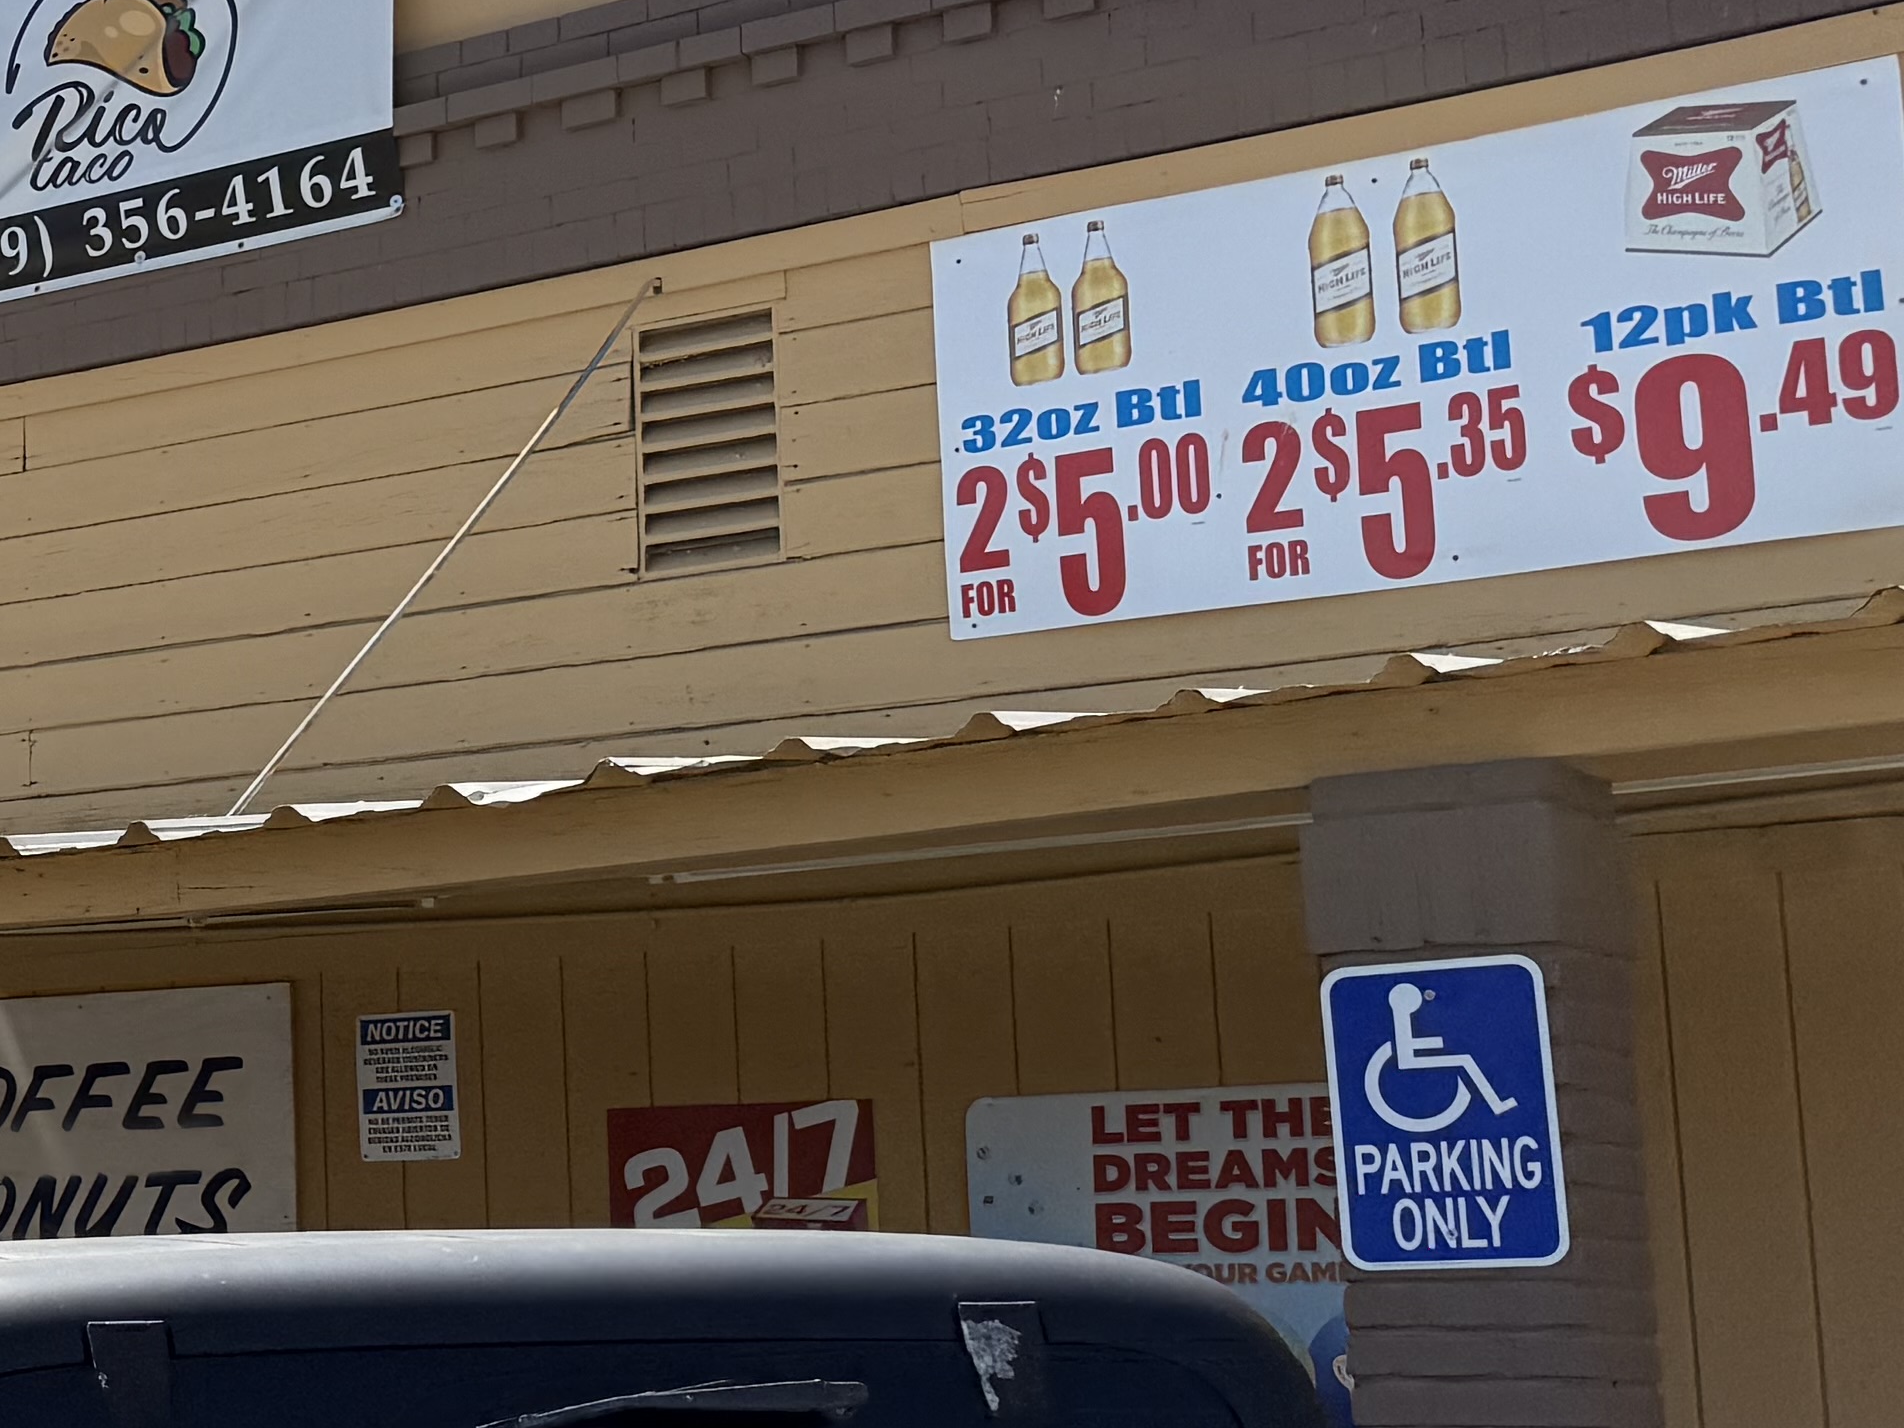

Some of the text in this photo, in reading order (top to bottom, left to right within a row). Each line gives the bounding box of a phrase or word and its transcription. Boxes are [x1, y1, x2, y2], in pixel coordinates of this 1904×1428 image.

[12, 80, 172, 153] Rico
[30, 146, 133, 191] taco
[1662, 162, 1718, 190] Miller
[83, 148, 374, 258] 356-4164
[1657, 193, 1726, 205] HIGH LIFE
[1580, 269, 1885, 355] 12pk Btl
[1241, 329, 1512, 408] 40oz Btl
[961, 379, 1202, 453] 32oz Btl
[1568, 329, 1900, 542] $9.49
[1247, 540, 1311, 581] FOR
[960, 578, 1016, 619] FOR
[366, 1019, 444, 1042] NOTICE
[373, 1088, 445, 1112] AVISO
[1091, 1097, 1333, 1145] LET THE
[1093, 1146, 1338, 1193] DREAMS
[1354, 1135, 1542, 1196] PARKING
[1095, 1198, 1341, 1255] BEGIN
[1393, 1195, 1510, 1251] ONLY
[1190, 1262, 1259, 1284] OUR
